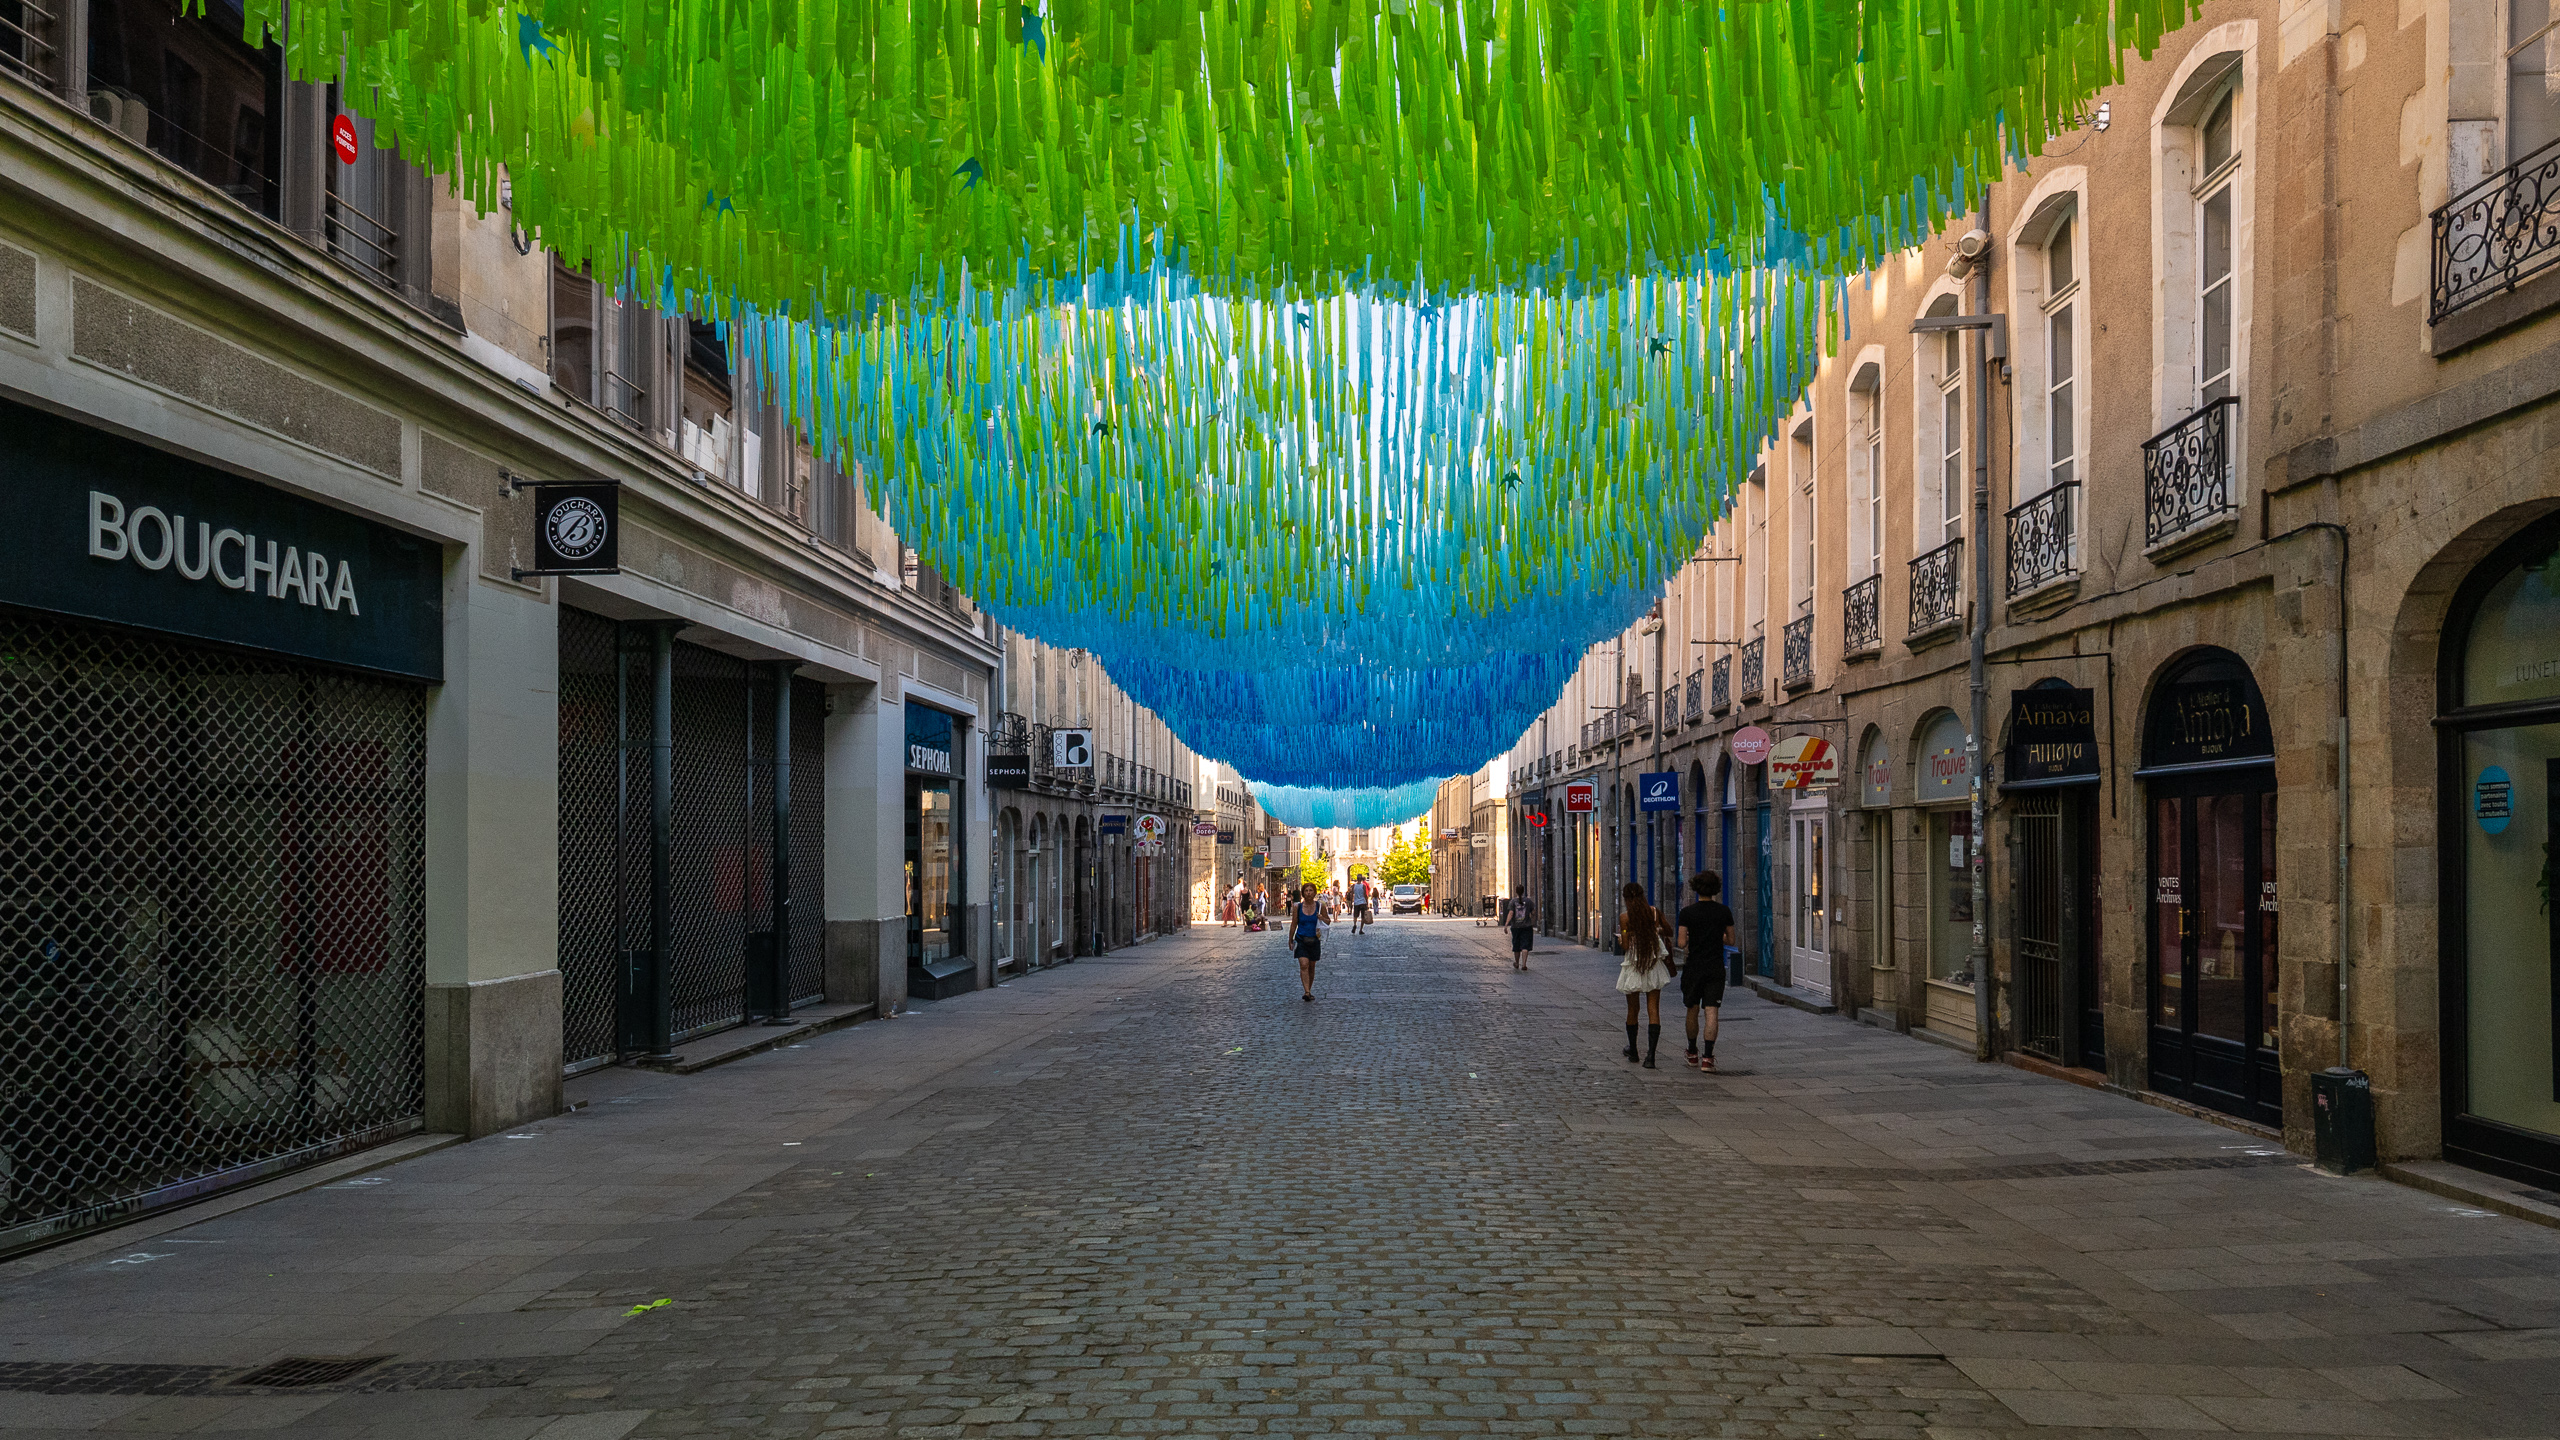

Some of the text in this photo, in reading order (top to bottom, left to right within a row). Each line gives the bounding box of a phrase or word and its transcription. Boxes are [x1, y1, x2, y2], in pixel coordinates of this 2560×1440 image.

[551, 501, 602, 524] BOUCHARA
[89, 490, 360, 616] BOUCHARA
[552, 534, 601, 555] DEPUIS 1899
[2516, 660, 2560, 682] LUNET
[2016, 703, 2090, 727] Amaya
[910, 744, 951, 774] SEPHORA
[1055, 733, 1063, 765] BOCAGE
[2201, 744, 2223, 754] BIJOUX
[1773, 759, 1834, 773] Trouvé
[1931, 749, 1966, 778] Trouvé
[1570, 793, 1592, 804] SFR
[2481, 792, 2507, 800] partenaires
[2158, 877, 2180, 888] VENTES
[2156, 889, 2182, 904] Archives
